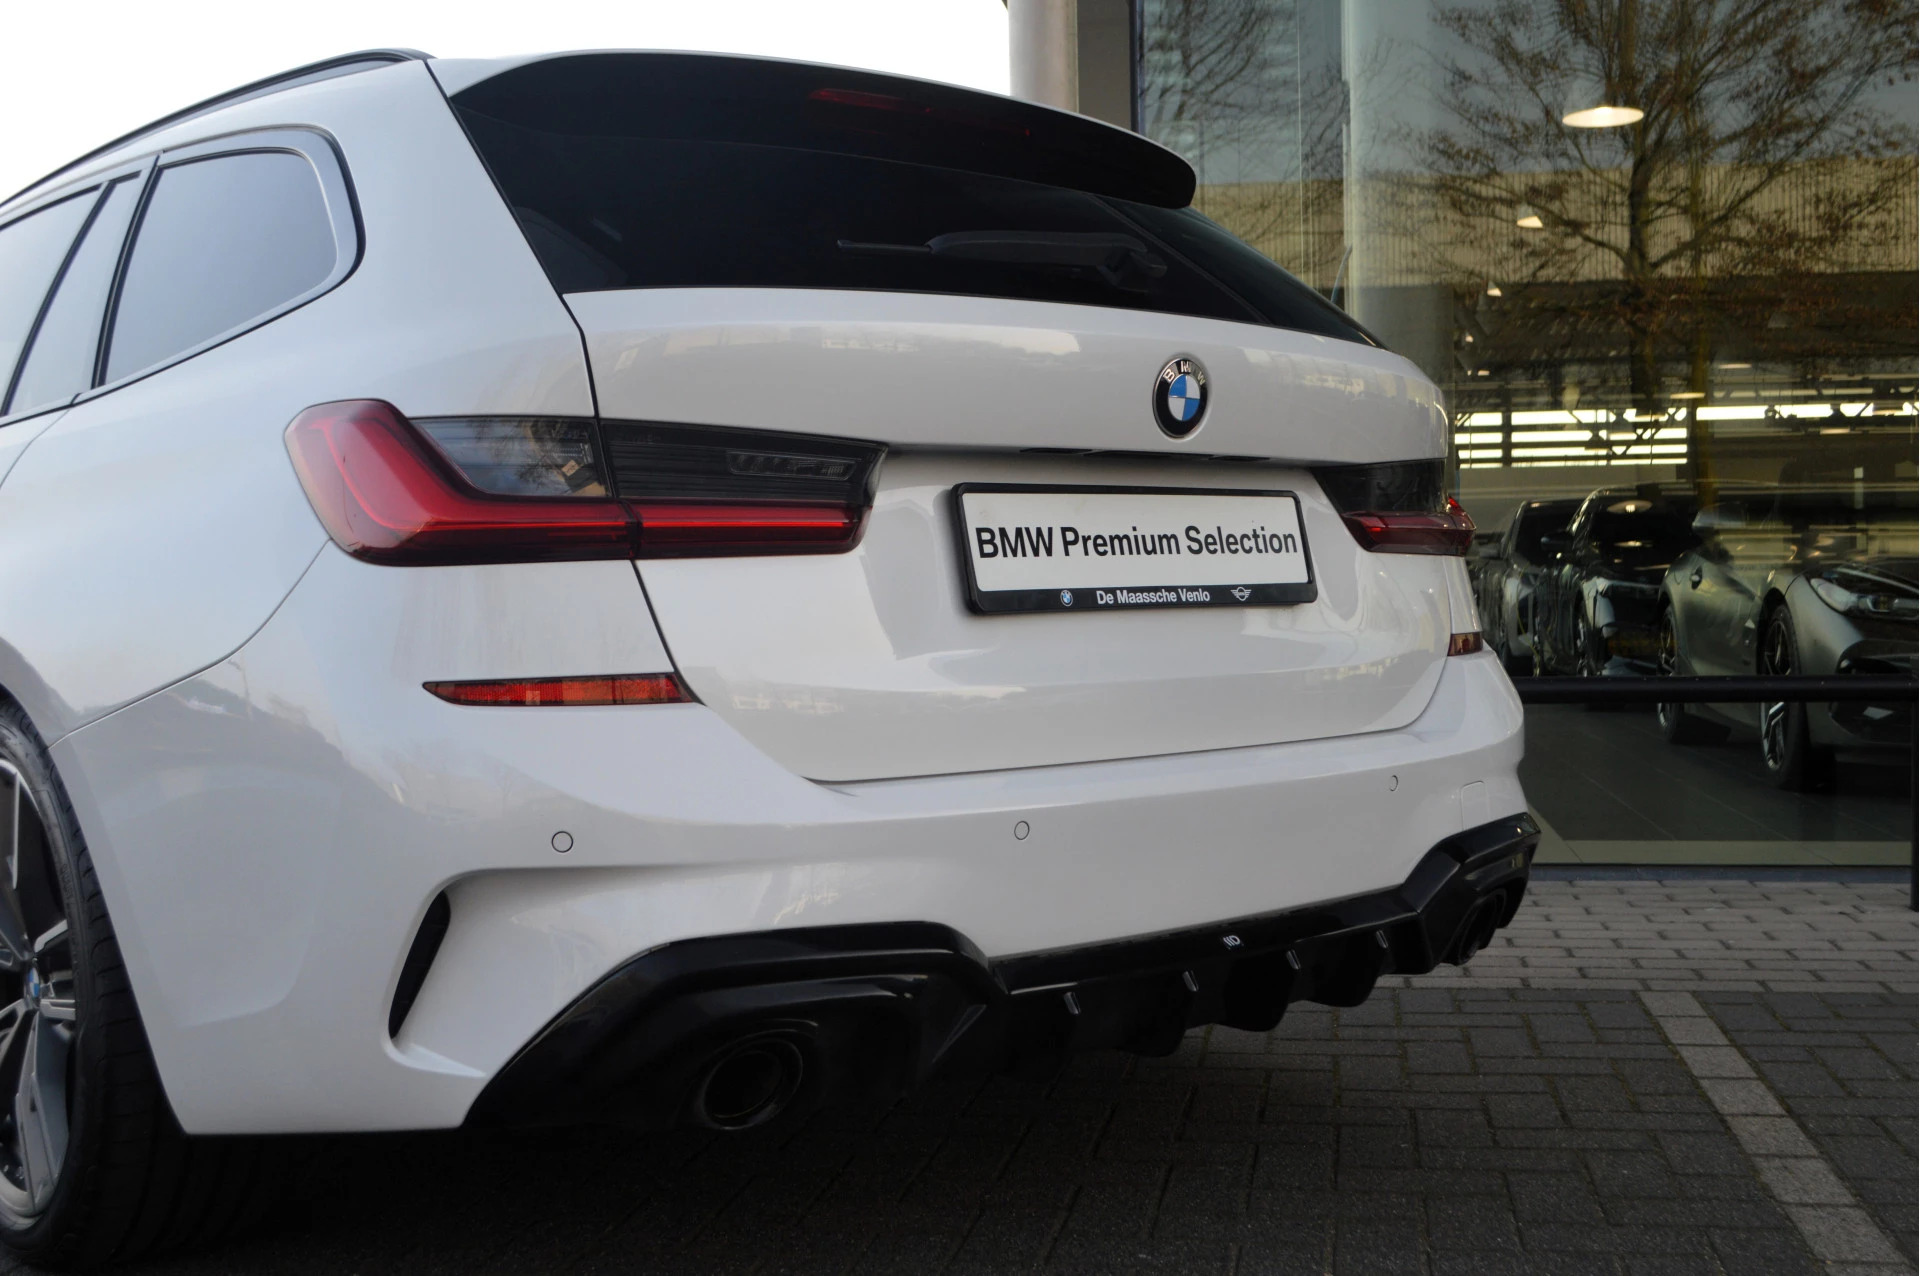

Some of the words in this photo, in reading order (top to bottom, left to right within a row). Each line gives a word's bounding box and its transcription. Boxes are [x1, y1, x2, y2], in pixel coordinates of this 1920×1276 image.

[1162, 360, 1206, 386] BMW
[975, 526, 1053, 559] BMW
[1061, 526, 1181, 557] Premium
[1185, 525, 1298, 554] Selection
[1096, 590, 1114, 605] De
[1116, 588, 1177, 604] Maassche
[1178, 588, 1211, 602] Venlo
